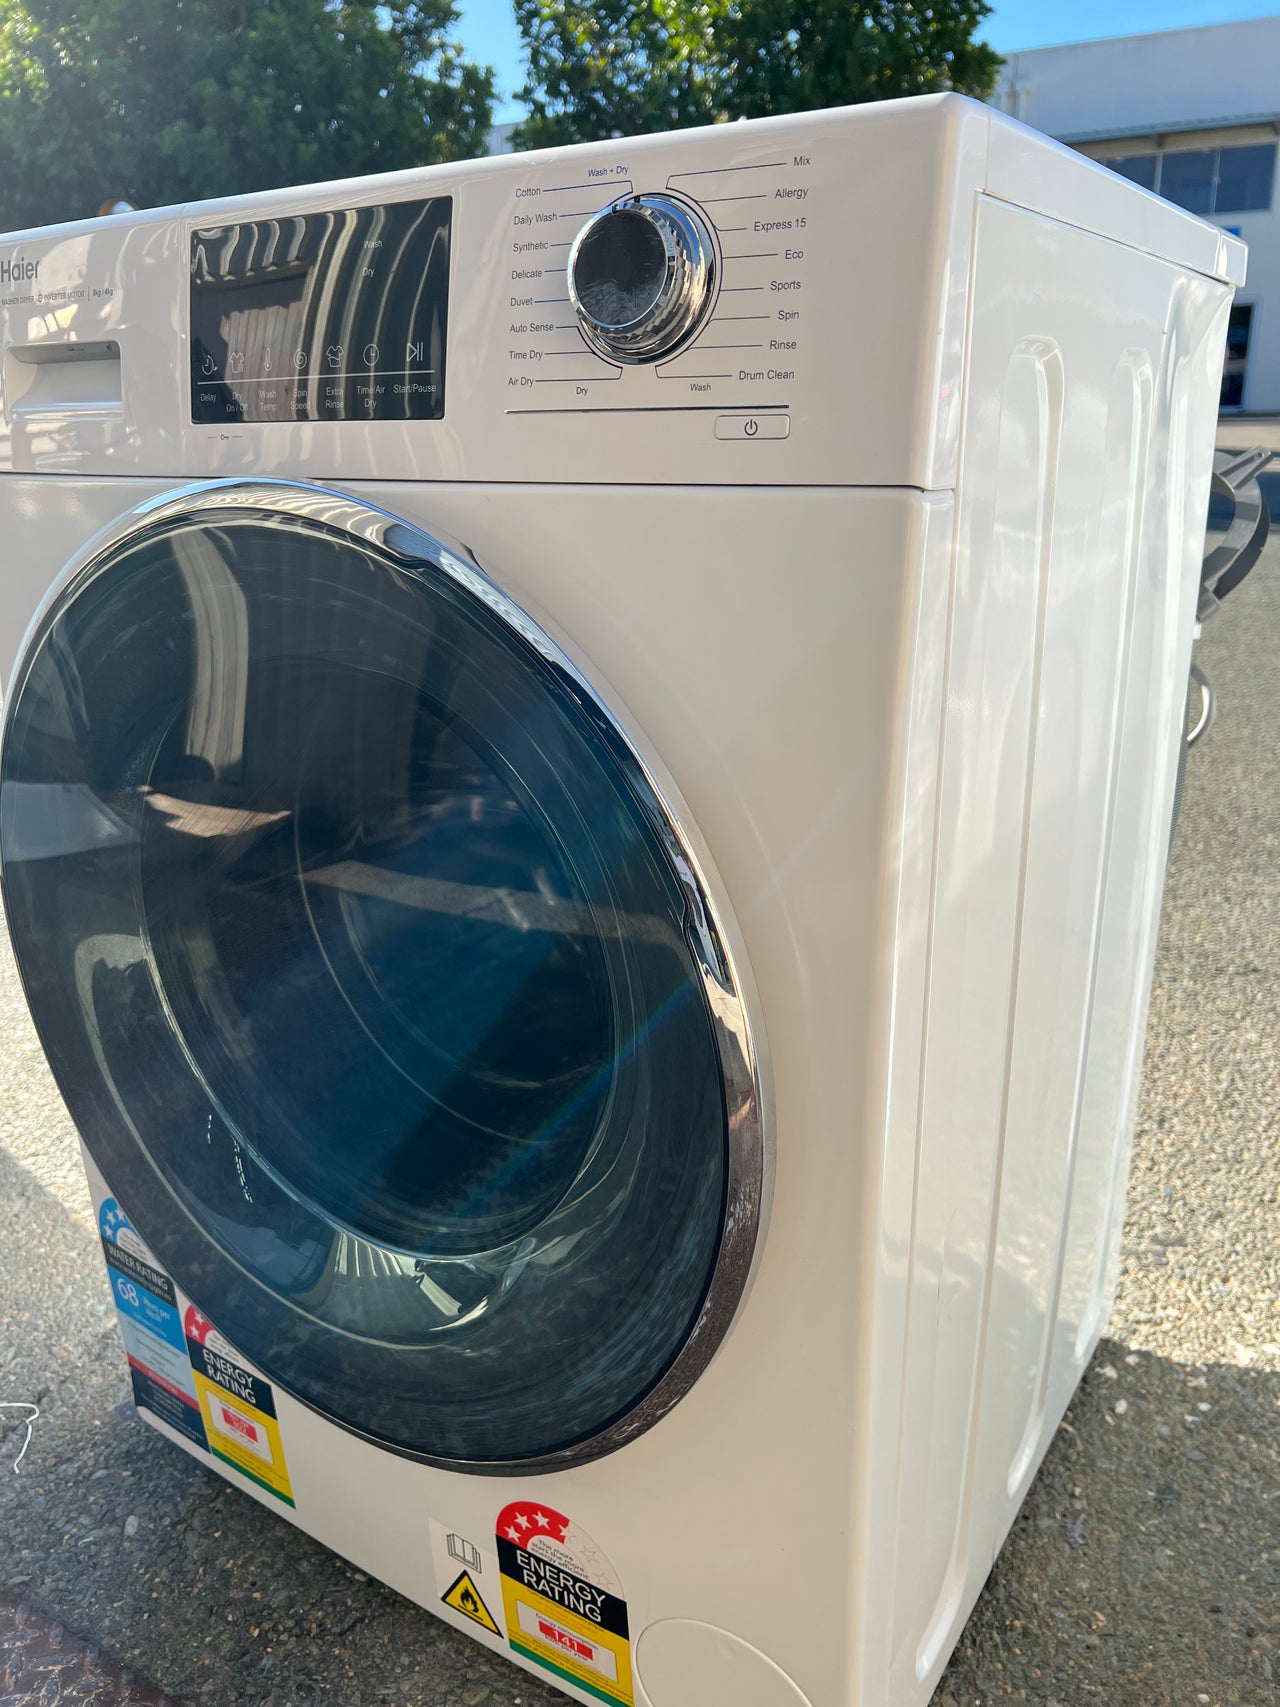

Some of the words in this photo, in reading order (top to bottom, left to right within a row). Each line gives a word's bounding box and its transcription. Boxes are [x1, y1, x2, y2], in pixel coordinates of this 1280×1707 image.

[793, 156, 811, 167] Mix
[588, 168, 608, 178] Wash
[616, 165, 630, 176] Dry
[515, 187, 541, 198] Cotton
[774, 188, 808, 200] Allergy
[513, 214, 534, 226] Daily
[535, 212, 558, 223] Wash
[753, 220, 793, 232] Express
[795, 218, 807, 228] 15
[363, 239, 383, 249] Wash
[512, 241, 549, 253] Synthetic
[785, 249, 804, 259] Eco
[0, 256, 39, 283] Haier
[362, 267, 375, 278] Dry
[511, 268, 543, 279] Delicate
[770, 280, 801, 292] Sports
[20, 295, 34, 305] DRYER
[43, 292, 67, 301] INVERTER
[67, 290, 85, 299] MOTOR
[510, 297, 533, 307] Duvet
[778, 310, 800, 322] Spin
[509, 323, 528, 333] Auto
[529, 322, 554, 332] Sense
[769, 339, 797, 349] Rinse
[509, 351, 528, 361] Time
[529, 350, 543, 361] Dry
[738, 370, 764, 381] Drum
[766, 369, 795, 380] Clean
[507, 376, 519, 387] Air
[520, 376, 534, 388] Dry
[690, 382, 712, 393] Wash
[259, 390, 277, 399] Wash
[293, 388, 308, 399] Spin
[326, 387, 344, 397] Extra
[357, 385, 386, 395] Time/Air
[393, 383, 437, 395] Start/Pause
[576, 386, 588, 397] Dry
[200, 392, 216, 403] Delay
[232, 391, 242, 402] Dry
[226, 404, 235, 413] On
[260, 402, 277, 412] Temp
[291, 401, 311, 411] Speed
[325, 400, 345, 409] Rinse
[364, 398, 377, 409] Dry
[107, 1244, 136, 1269] WATER
[136, 1262, 168, 1290] RATING
[117, 1278, 139, 1307] 68
[202, 1348, 253, 1388] ENERGY
[207, 1364, 256, 1404] RATING
[516, 1549, 606, 1608] ENERGY
[523, 1568, 601, 1622] RATING
[553, 1629, 579, 1651] 141
